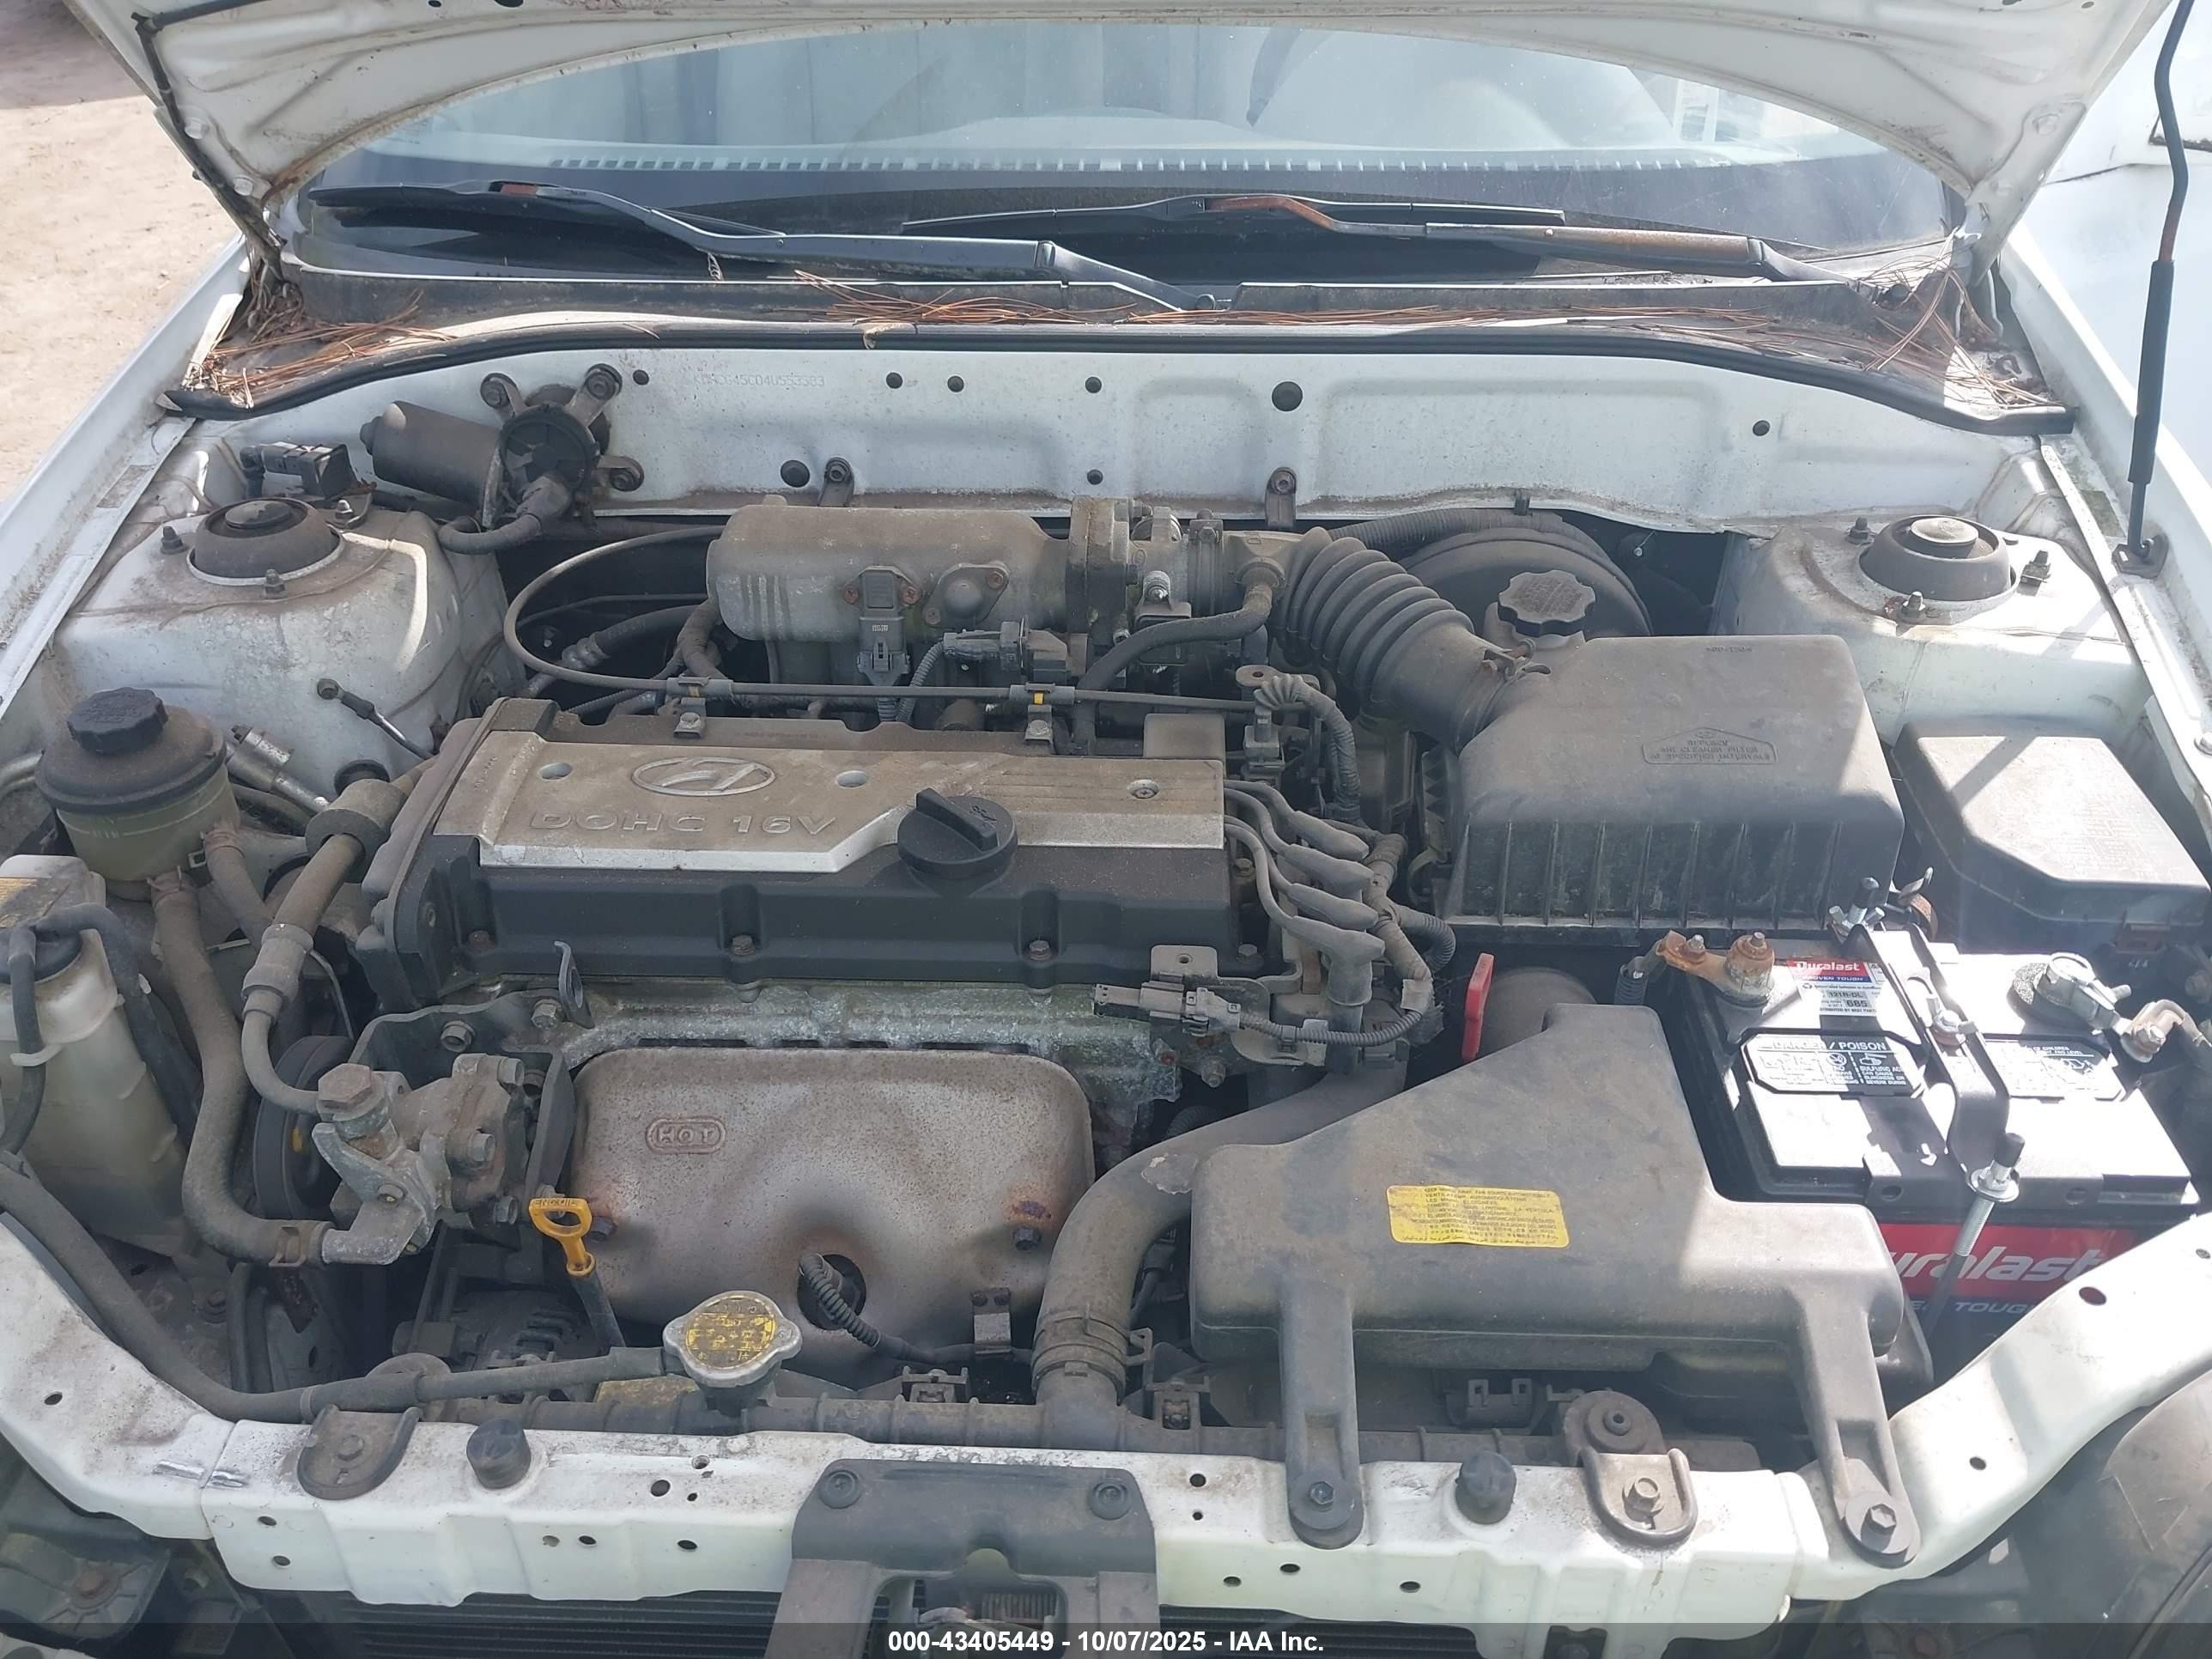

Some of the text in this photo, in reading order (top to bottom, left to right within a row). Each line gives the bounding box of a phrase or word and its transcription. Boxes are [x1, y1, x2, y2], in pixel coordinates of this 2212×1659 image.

[528, 812, 836, 835] DOHC 16V
[1795, 961, 1861, 971] Duralast
[1846, 1000, 1868, 1008] 685
[1838, 1042, 1887, 1050] POISON
[655, 1126, 715, 1144] HOT
[1955, 1301, 2032, 1314] TOUG
